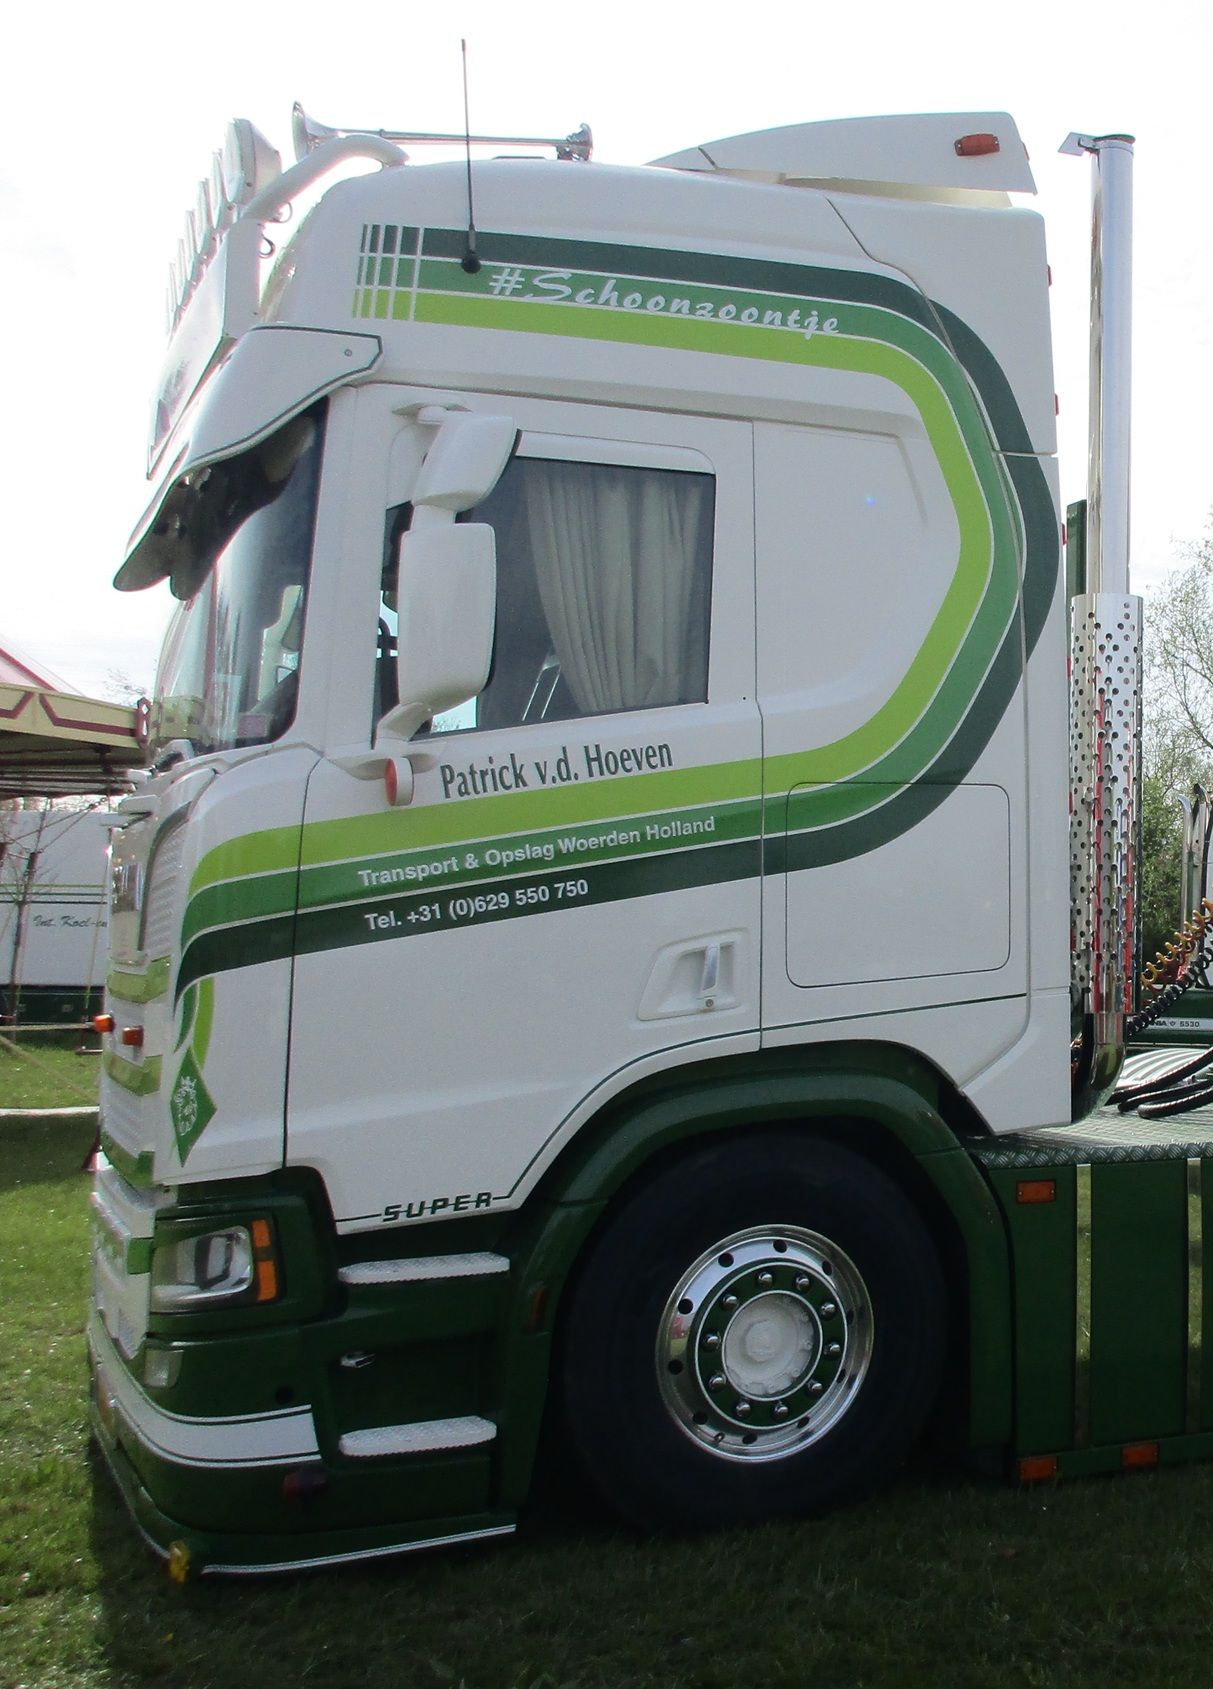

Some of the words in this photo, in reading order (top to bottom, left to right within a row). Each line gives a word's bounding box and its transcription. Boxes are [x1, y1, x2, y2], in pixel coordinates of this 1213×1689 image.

[488, 267, 840, 339] #Schoonzoontje
[440, 753, 529, 799] Patrick
[534, 746, 579, 786] v.d.
[584, 742, 674, 778] Hoeven
[357, 857, 460, 886] Transport
[465, 853, 480, 869] &
[485, 843, 555, 867] Opslag
[558, 830, 641, 854] Woerden
[645, 816, 716, 841] Holland
[363, 910, 402, 930] Tel.
[406, 903, 441, 922] +31
[448, 892, 510, 920] (0)629
[515, 885, 550, 905] 550
[554, 879, 589, 899] 750
[382, 1191, 493, 1222] SUPER
